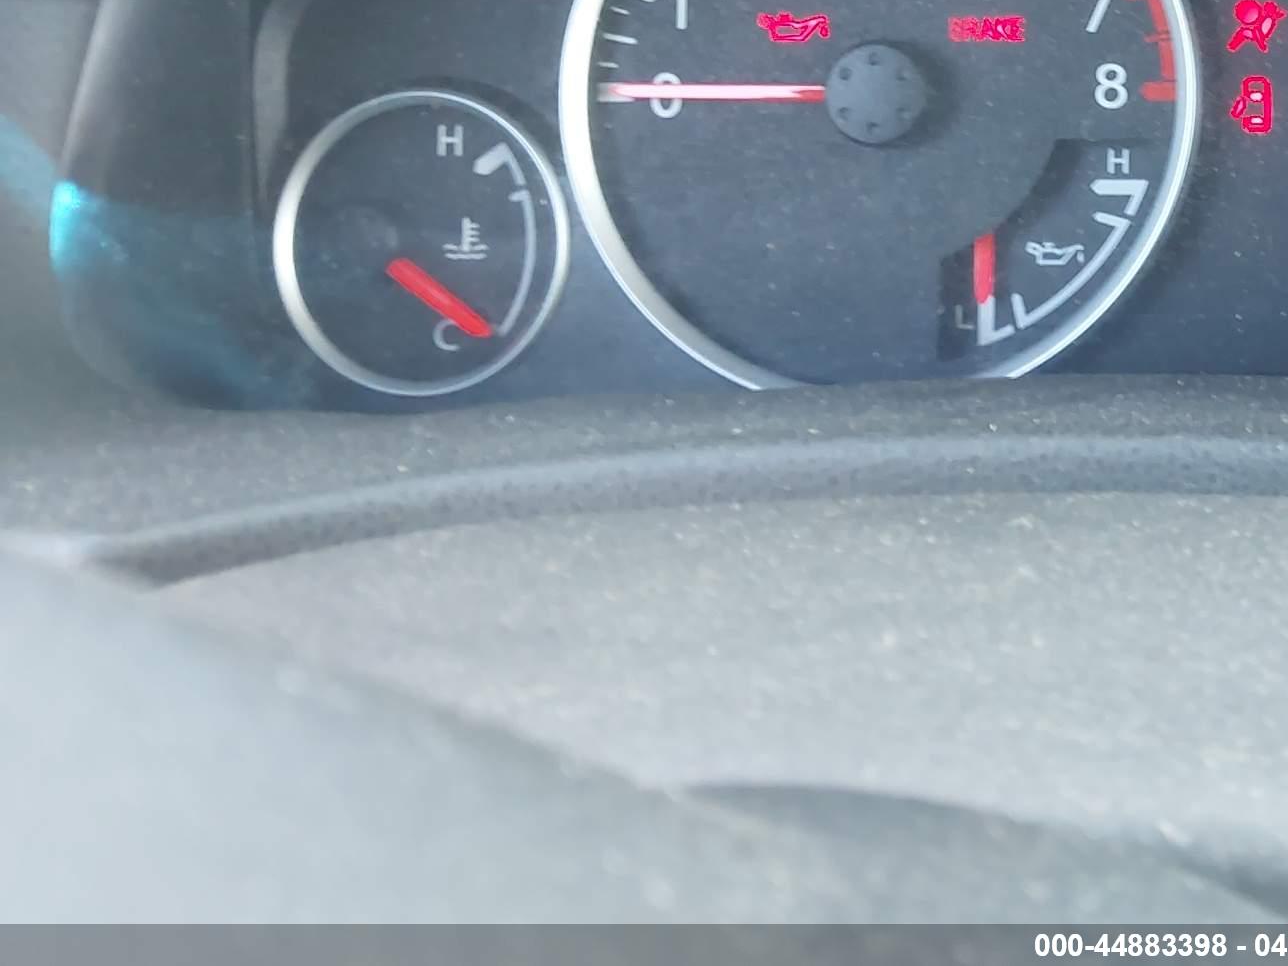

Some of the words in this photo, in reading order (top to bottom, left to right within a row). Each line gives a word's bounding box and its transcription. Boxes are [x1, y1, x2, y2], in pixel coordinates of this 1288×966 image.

[948, 15, 1025, 43] BRAKE
[649, 73, 684, 118] 0
[1094, 63, 1129, 109] 8
[436, 124, 463, 157] H
[1106, 148, 1130, 174] H
